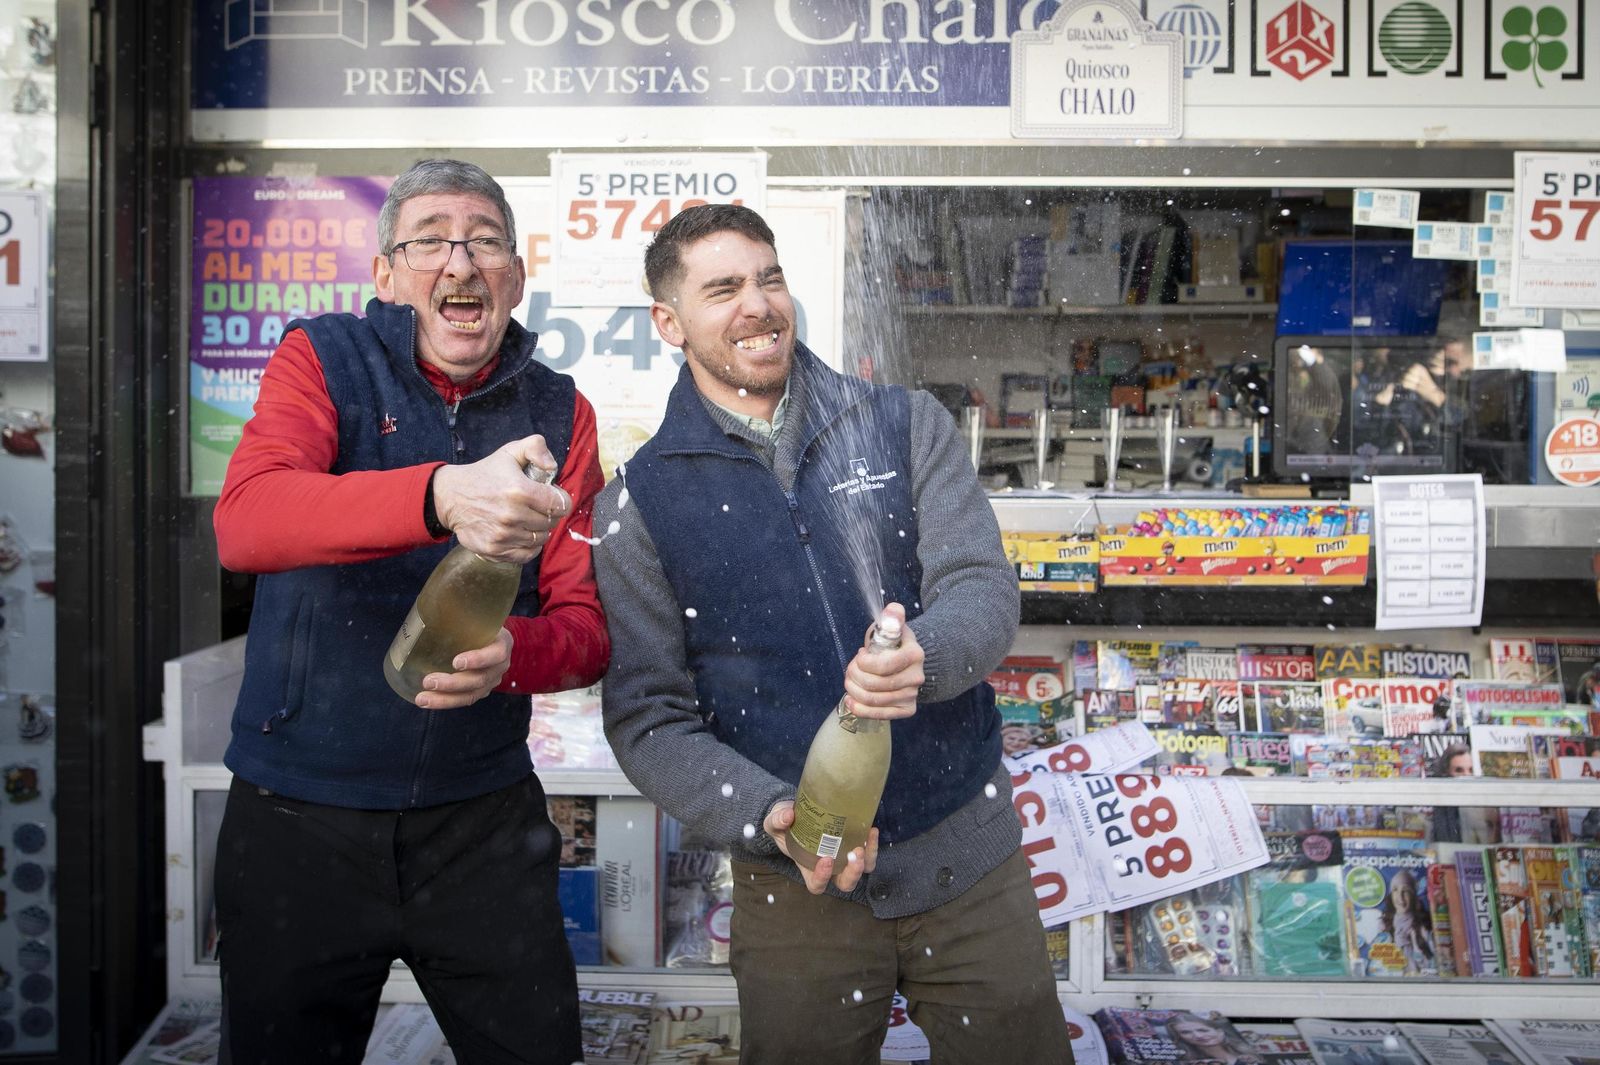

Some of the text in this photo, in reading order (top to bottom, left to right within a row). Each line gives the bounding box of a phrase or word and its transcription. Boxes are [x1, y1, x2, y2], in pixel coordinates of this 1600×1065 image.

[381, 0, 735, 48] Kiosco
[344, 59, 940, 96] PRENSA REVISTAS LOTERÍAS
[1065, 57, 1130, 83] Quiosco
[1060, 87, 1135, 115] CHALO
[608, 172, 738, 196] PREMIO
[203, 218, 367, 248] 20.000€
[203, 253, 338, 281] AL MES
[202, 315, 250, 346] 30
[219, 368, 265, 384] MUC
[1560, 422, 1598, 448] +18
[1020, 570, 1045, 580] KIND
[1383, 651, 1469, 677] HISTORIA
